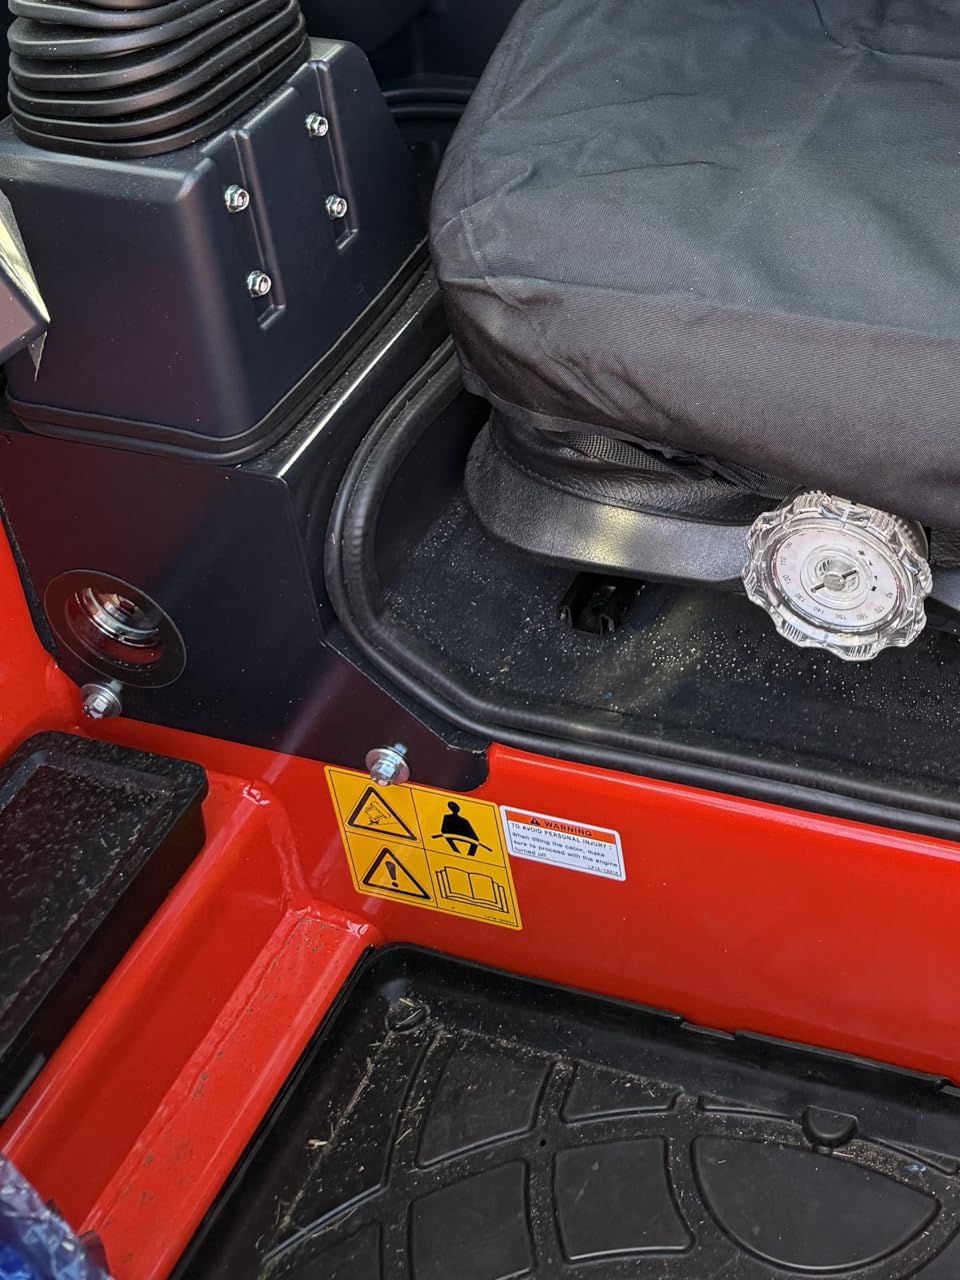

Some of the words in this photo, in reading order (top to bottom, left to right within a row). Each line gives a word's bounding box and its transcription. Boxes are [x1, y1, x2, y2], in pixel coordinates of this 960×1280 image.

[521, 825, 542, 834] AVOID
[544, 830, 580, 843] PERSONAL
[582, 838, 606, 848] INJURY
[543, 820, 592, 837] WARNING
